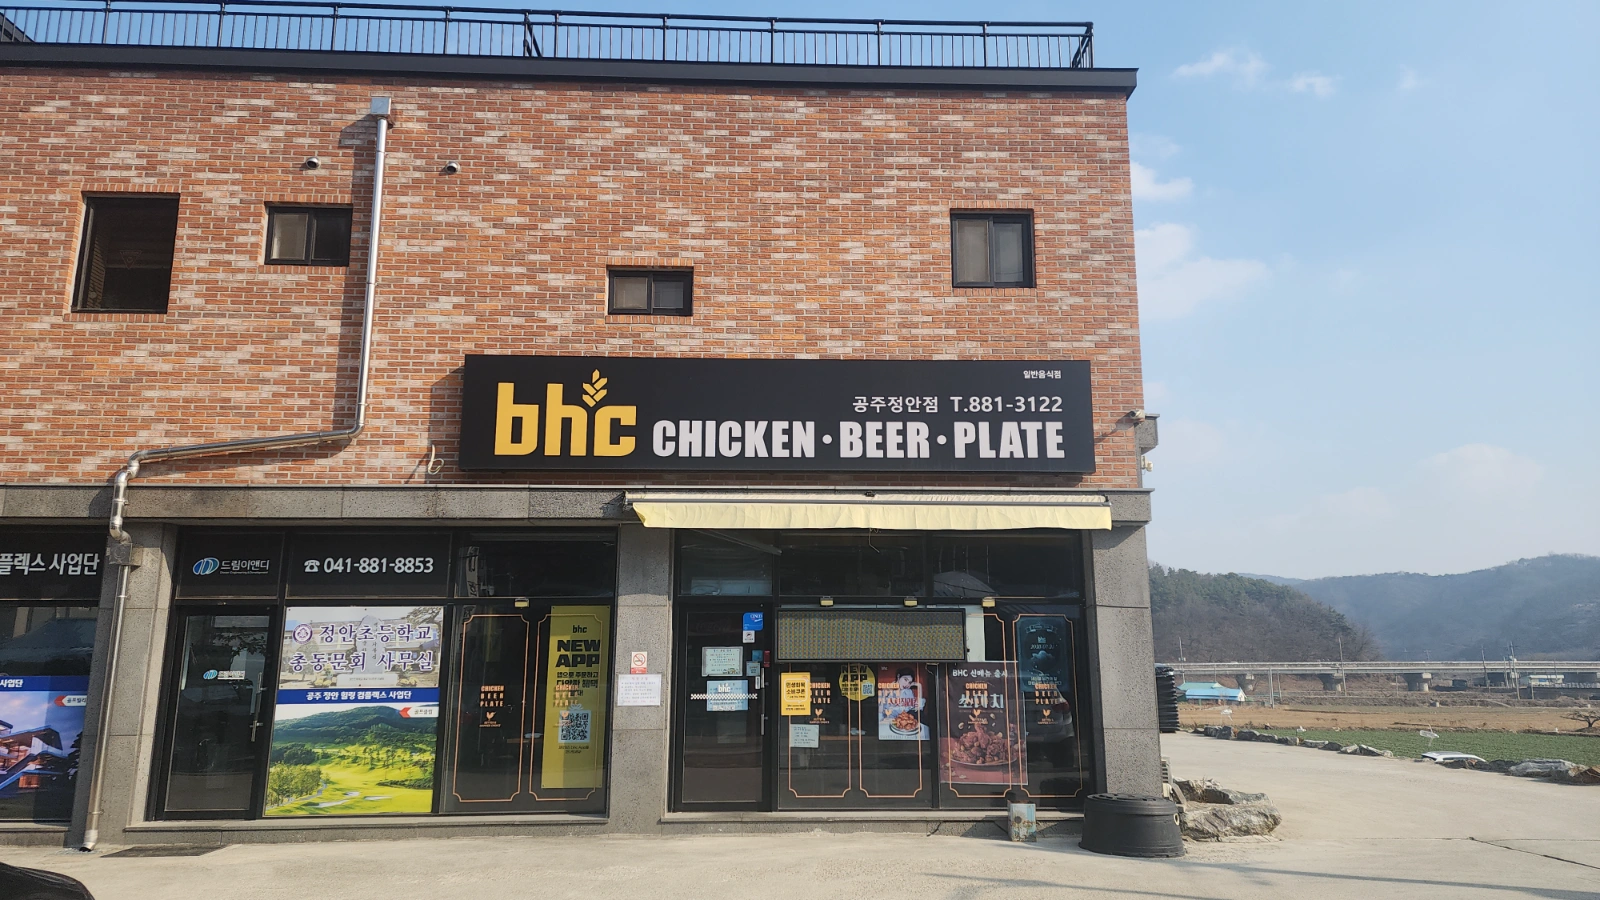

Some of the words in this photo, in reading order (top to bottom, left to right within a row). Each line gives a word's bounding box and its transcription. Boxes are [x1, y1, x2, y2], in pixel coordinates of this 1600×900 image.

[1022, 369, 1062, 379] 일반음식점
[852, 396, 938, 413] 공주정안점
[950, 396, 1063, 412] T.881-3122
[494, 381, 637, 457] bhc
[652, 419, 815, 458] CHICKEN
[839, 421, 930, 458] BEER
[953, 421, 1065, 459] PLATE
[49, 553, 100, 576] 사업단
[220, 559, 270, 571] 드림이앤디
[323, 557, 434, 574] 041-881-8853
[319, 624, 432, 643] 정안초등학교
[572, 625, 588, 633] bhc
[556, 639, 600, 652] NEW
[289, 652, 366, 672] 총동문회
[377, 651, 434, 671] 사무실
[555, 654, 600, 668] APP
[952, 669, 968, 677] BHC
[970, 669, 991, 678] 신메뉴
[0, 679, 24, 688] 사업단
[718, 684, 731, 693] bhc
[306, 692, 322, 700] 공주
[323, 692, 339, 700] 정안
[341, 691, 356, 700] 힐링
[388, 691, 412, 700] 사업단
